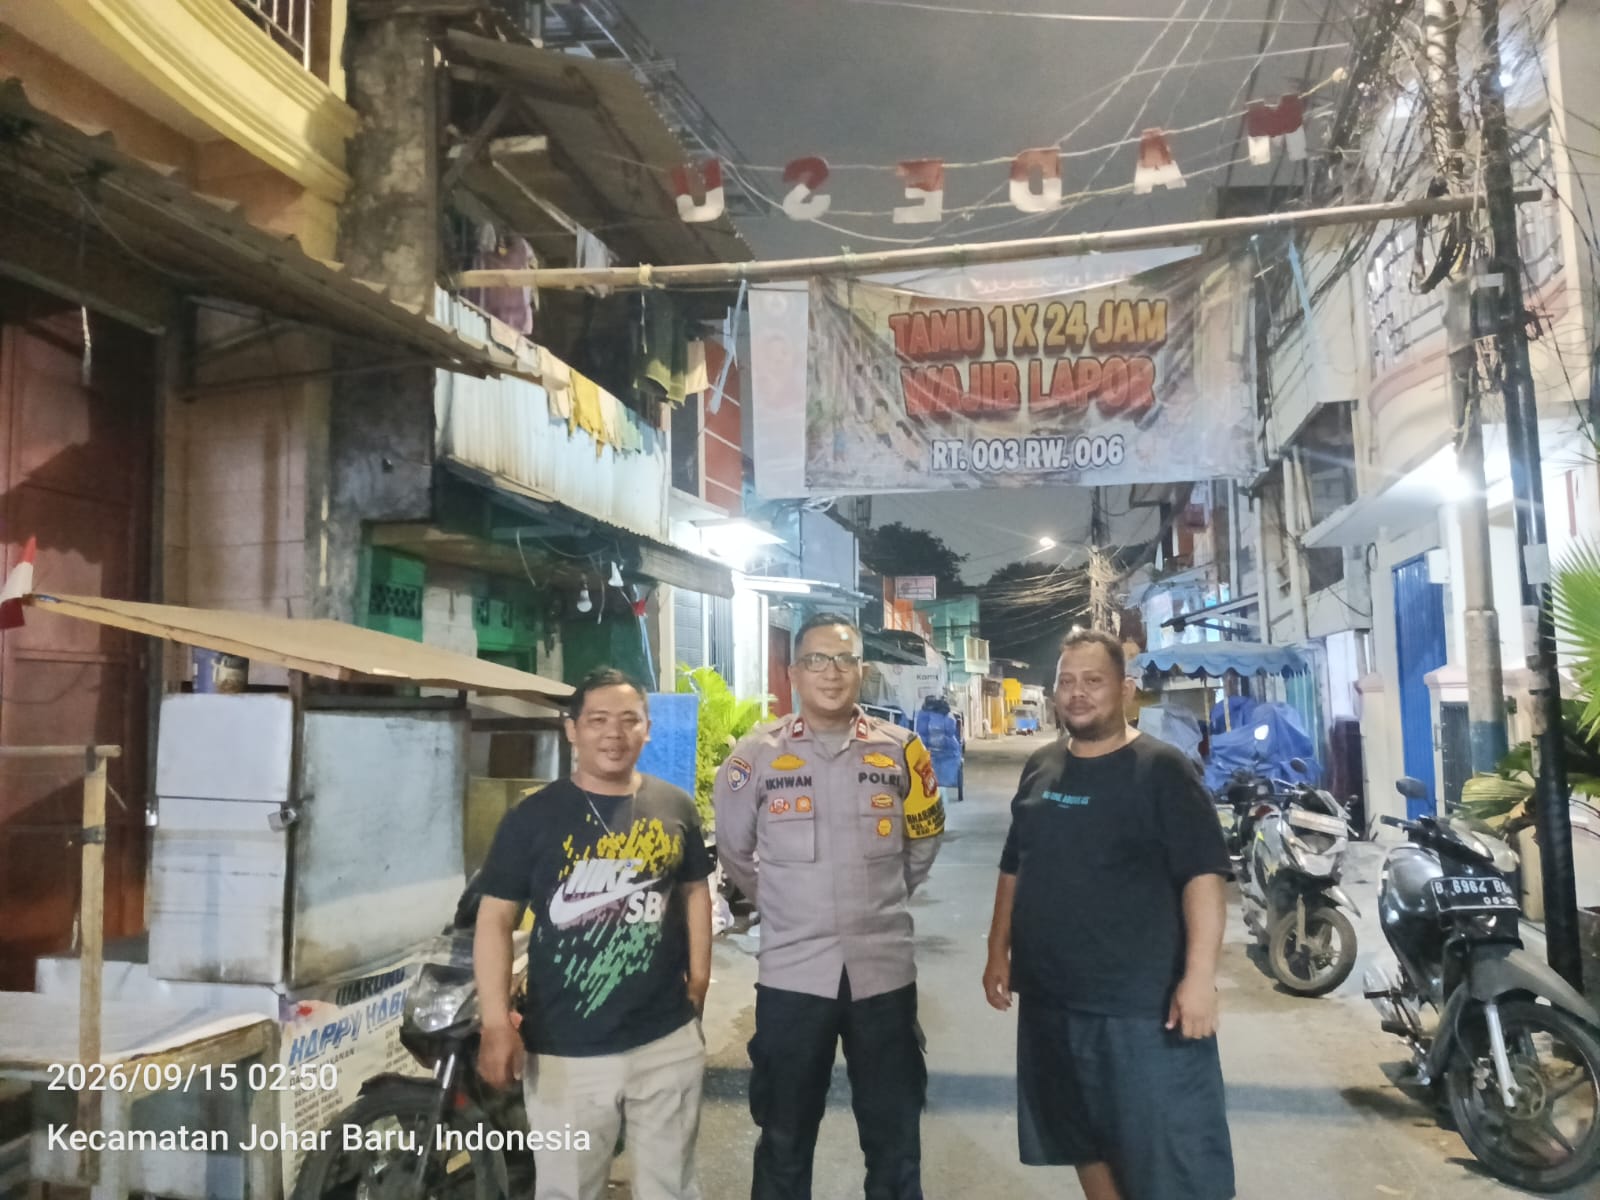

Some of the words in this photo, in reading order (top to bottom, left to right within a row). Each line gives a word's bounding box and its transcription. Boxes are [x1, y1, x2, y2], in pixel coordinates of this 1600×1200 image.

[889, 306, 985, 359] TAMU
[988, 305, 1008, 352] 1
[1012, 302, 1041, 350] X
[1043, 301, 1090, 350] 24
[1093, 297, 1168, 346] JAM
[901, 360, 1022, 418] WAJIB
[1028, 355, 1157, 422] LAPOR
[931, 437, 970, 470] RT.
[972, 438, 1020, 470] 003
[1022, 436, 1071, 469] RW.
[1074, 434, 1125, 468] 006
[765, 775, 813, 790] IKHWAN
[624, 890, 664, 923] SB
[288, 1011, 362, 1067] HAPPY
